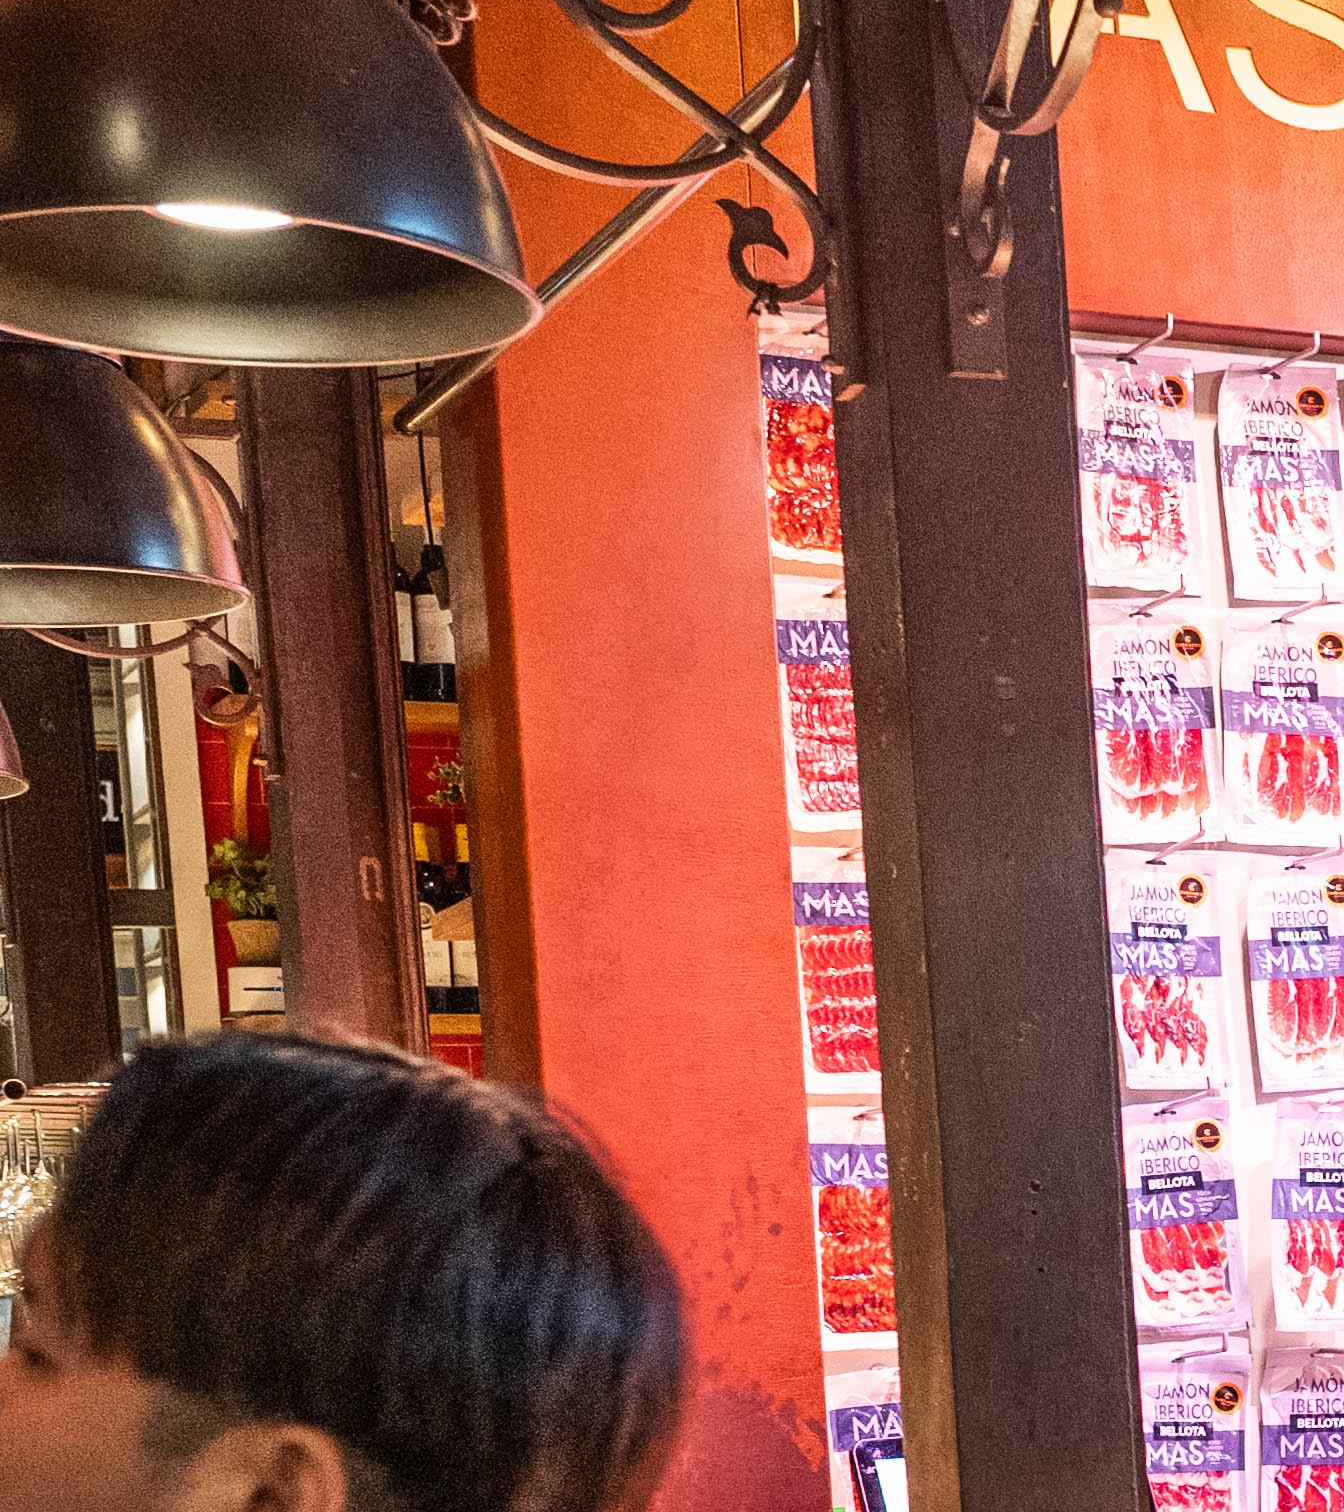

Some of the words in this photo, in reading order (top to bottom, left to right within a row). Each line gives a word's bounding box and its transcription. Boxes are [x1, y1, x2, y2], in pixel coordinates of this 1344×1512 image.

[790, 628, 849, 658] MA
[1277, 930, 1323, 942] BELLOTA
[1121, 942, 1178, 970] MAS
[1266, 945, 1324, 973] MAS
[1148, 1176, 1196, 1190] BELLOTA
[1134, 1191, 1195, 1223] MAS
[852, 1409, 905, 1440] MA
[1159, 1425, 1207, 1438] BELLOTA
[1145, 1440, 1206, 1467] MAS
[1280, 1433, 1344, 1459] MAS
